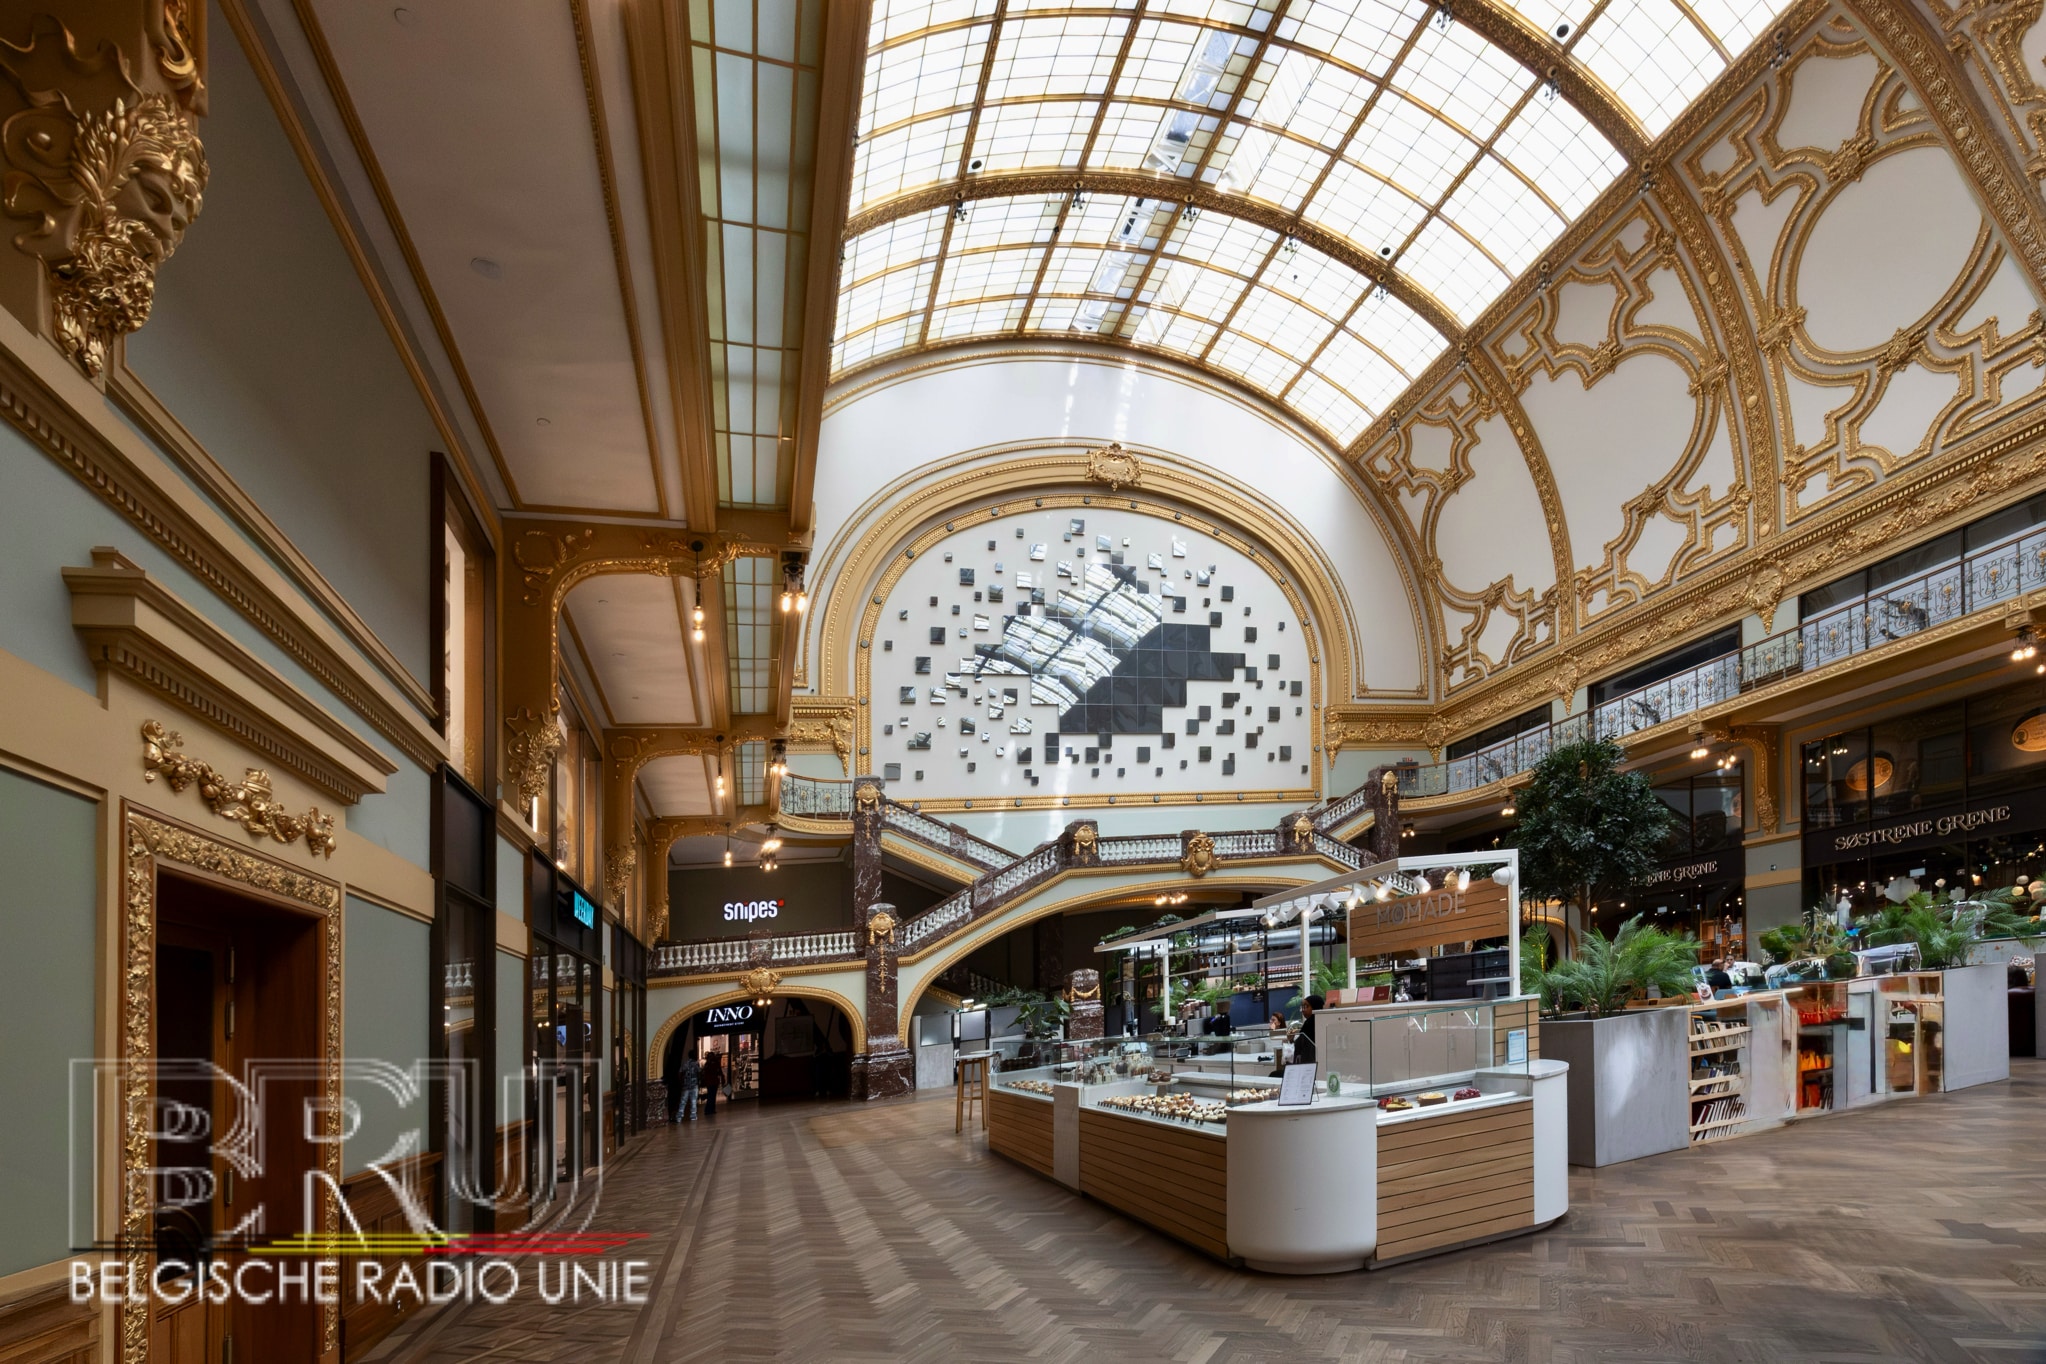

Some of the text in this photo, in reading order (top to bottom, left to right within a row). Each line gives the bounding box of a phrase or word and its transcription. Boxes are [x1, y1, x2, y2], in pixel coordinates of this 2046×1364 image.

[1834, 805, 2010, 851] SØSTRENE GRENE
[1673, 861, 1718, 882] GRENE
[1376, 890, 1467, 928] MOMADE
[707, 1006, 752, 1022] INNO
